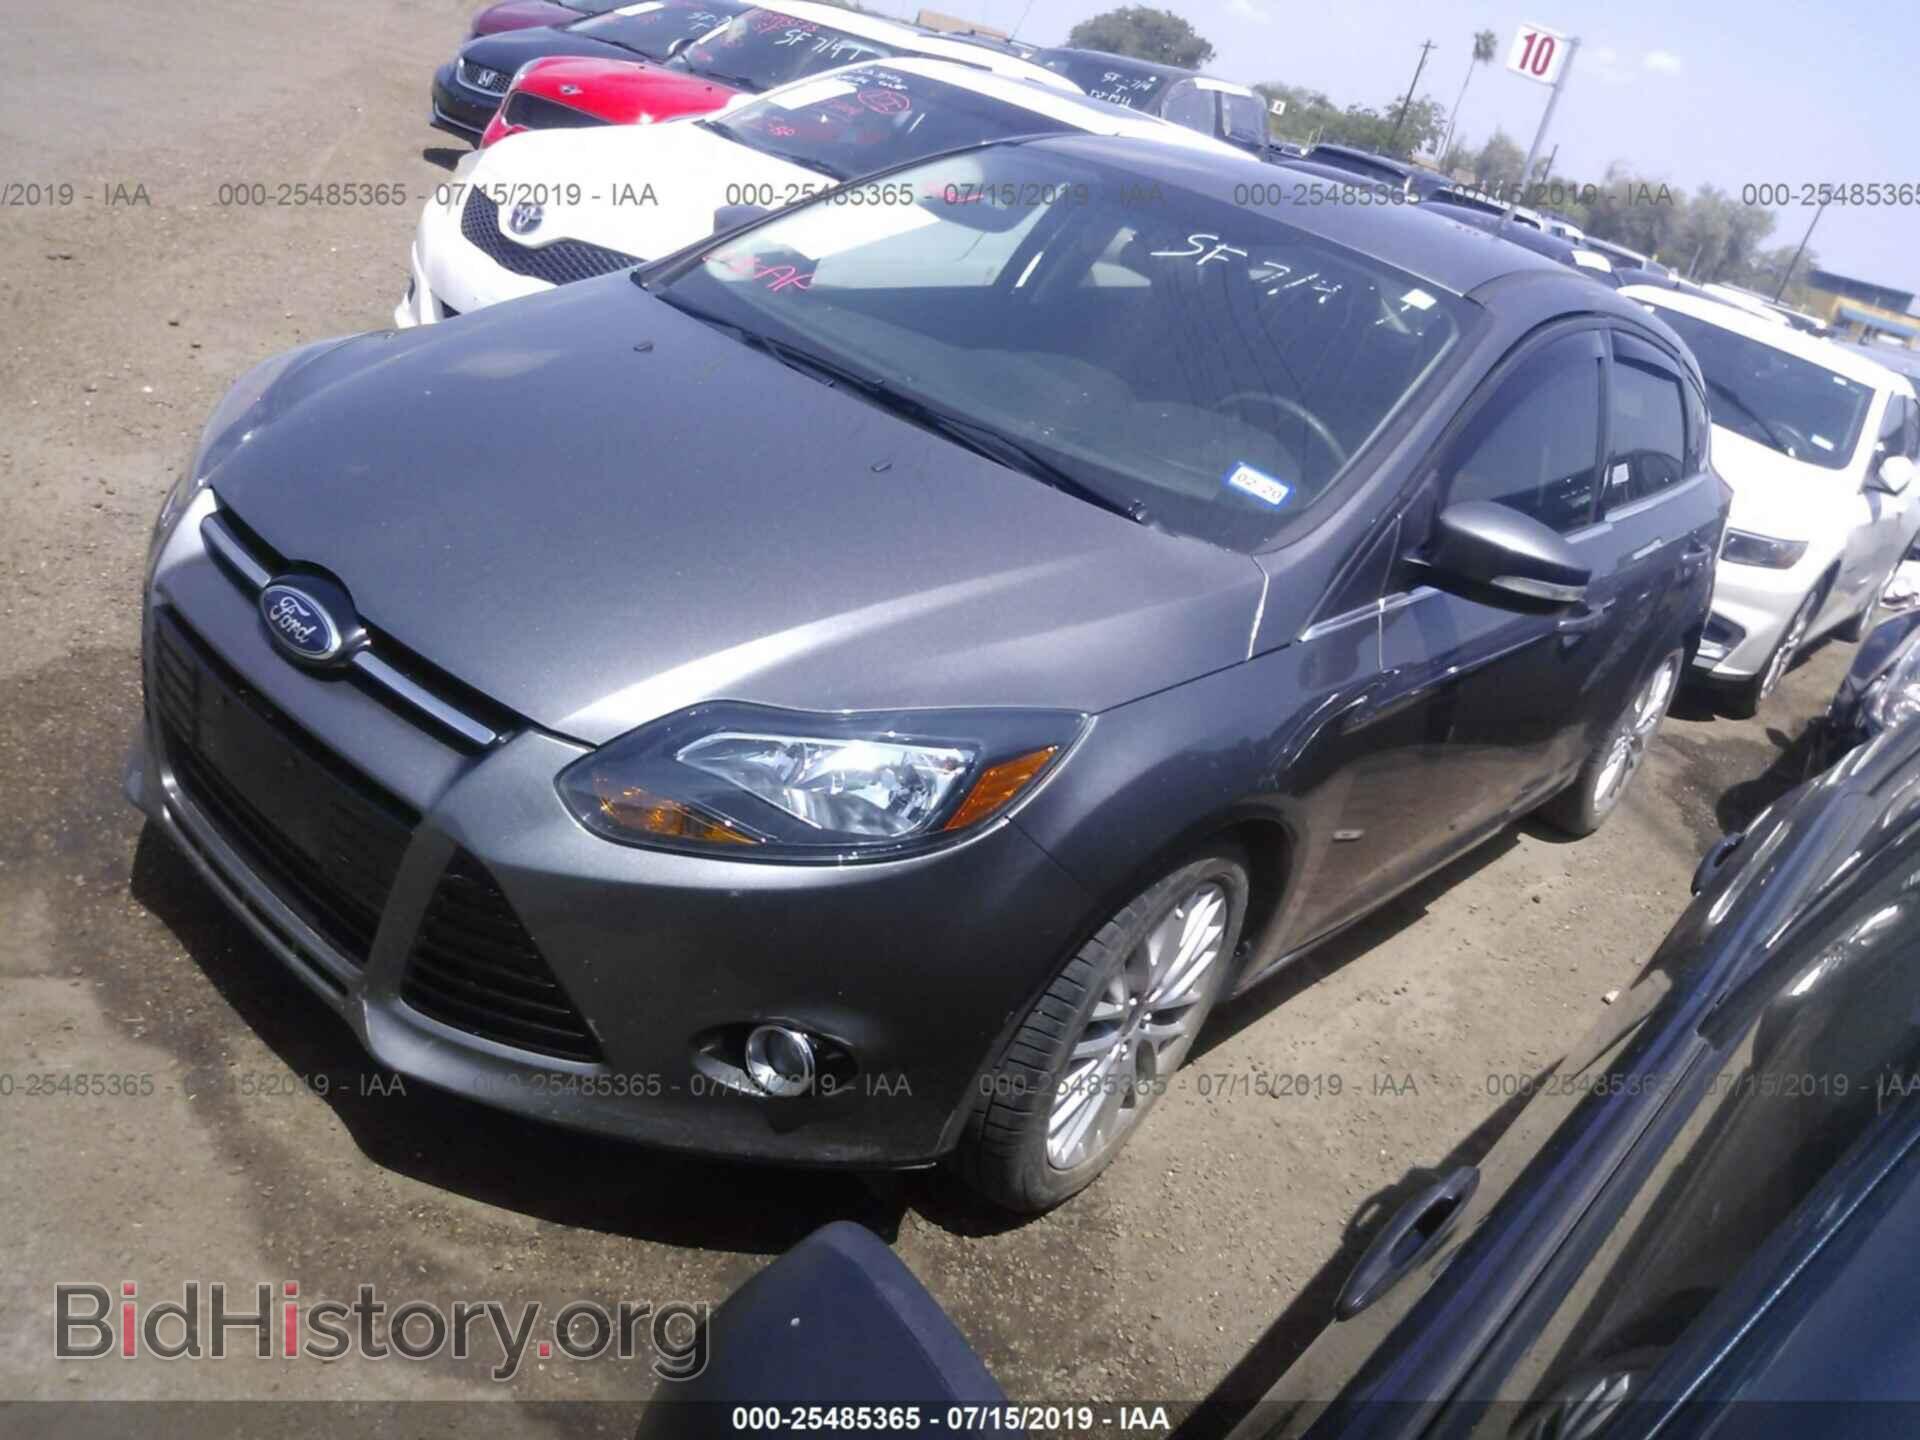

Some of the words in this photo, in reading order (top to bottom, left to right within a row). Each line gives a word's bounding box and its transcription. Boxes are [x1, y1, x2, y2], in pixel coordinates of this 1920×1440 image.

[1519, 32, 1555, 76] 10
[1150, 234, 1248, 265] SF
[269, 596, 317, 643] Ford
